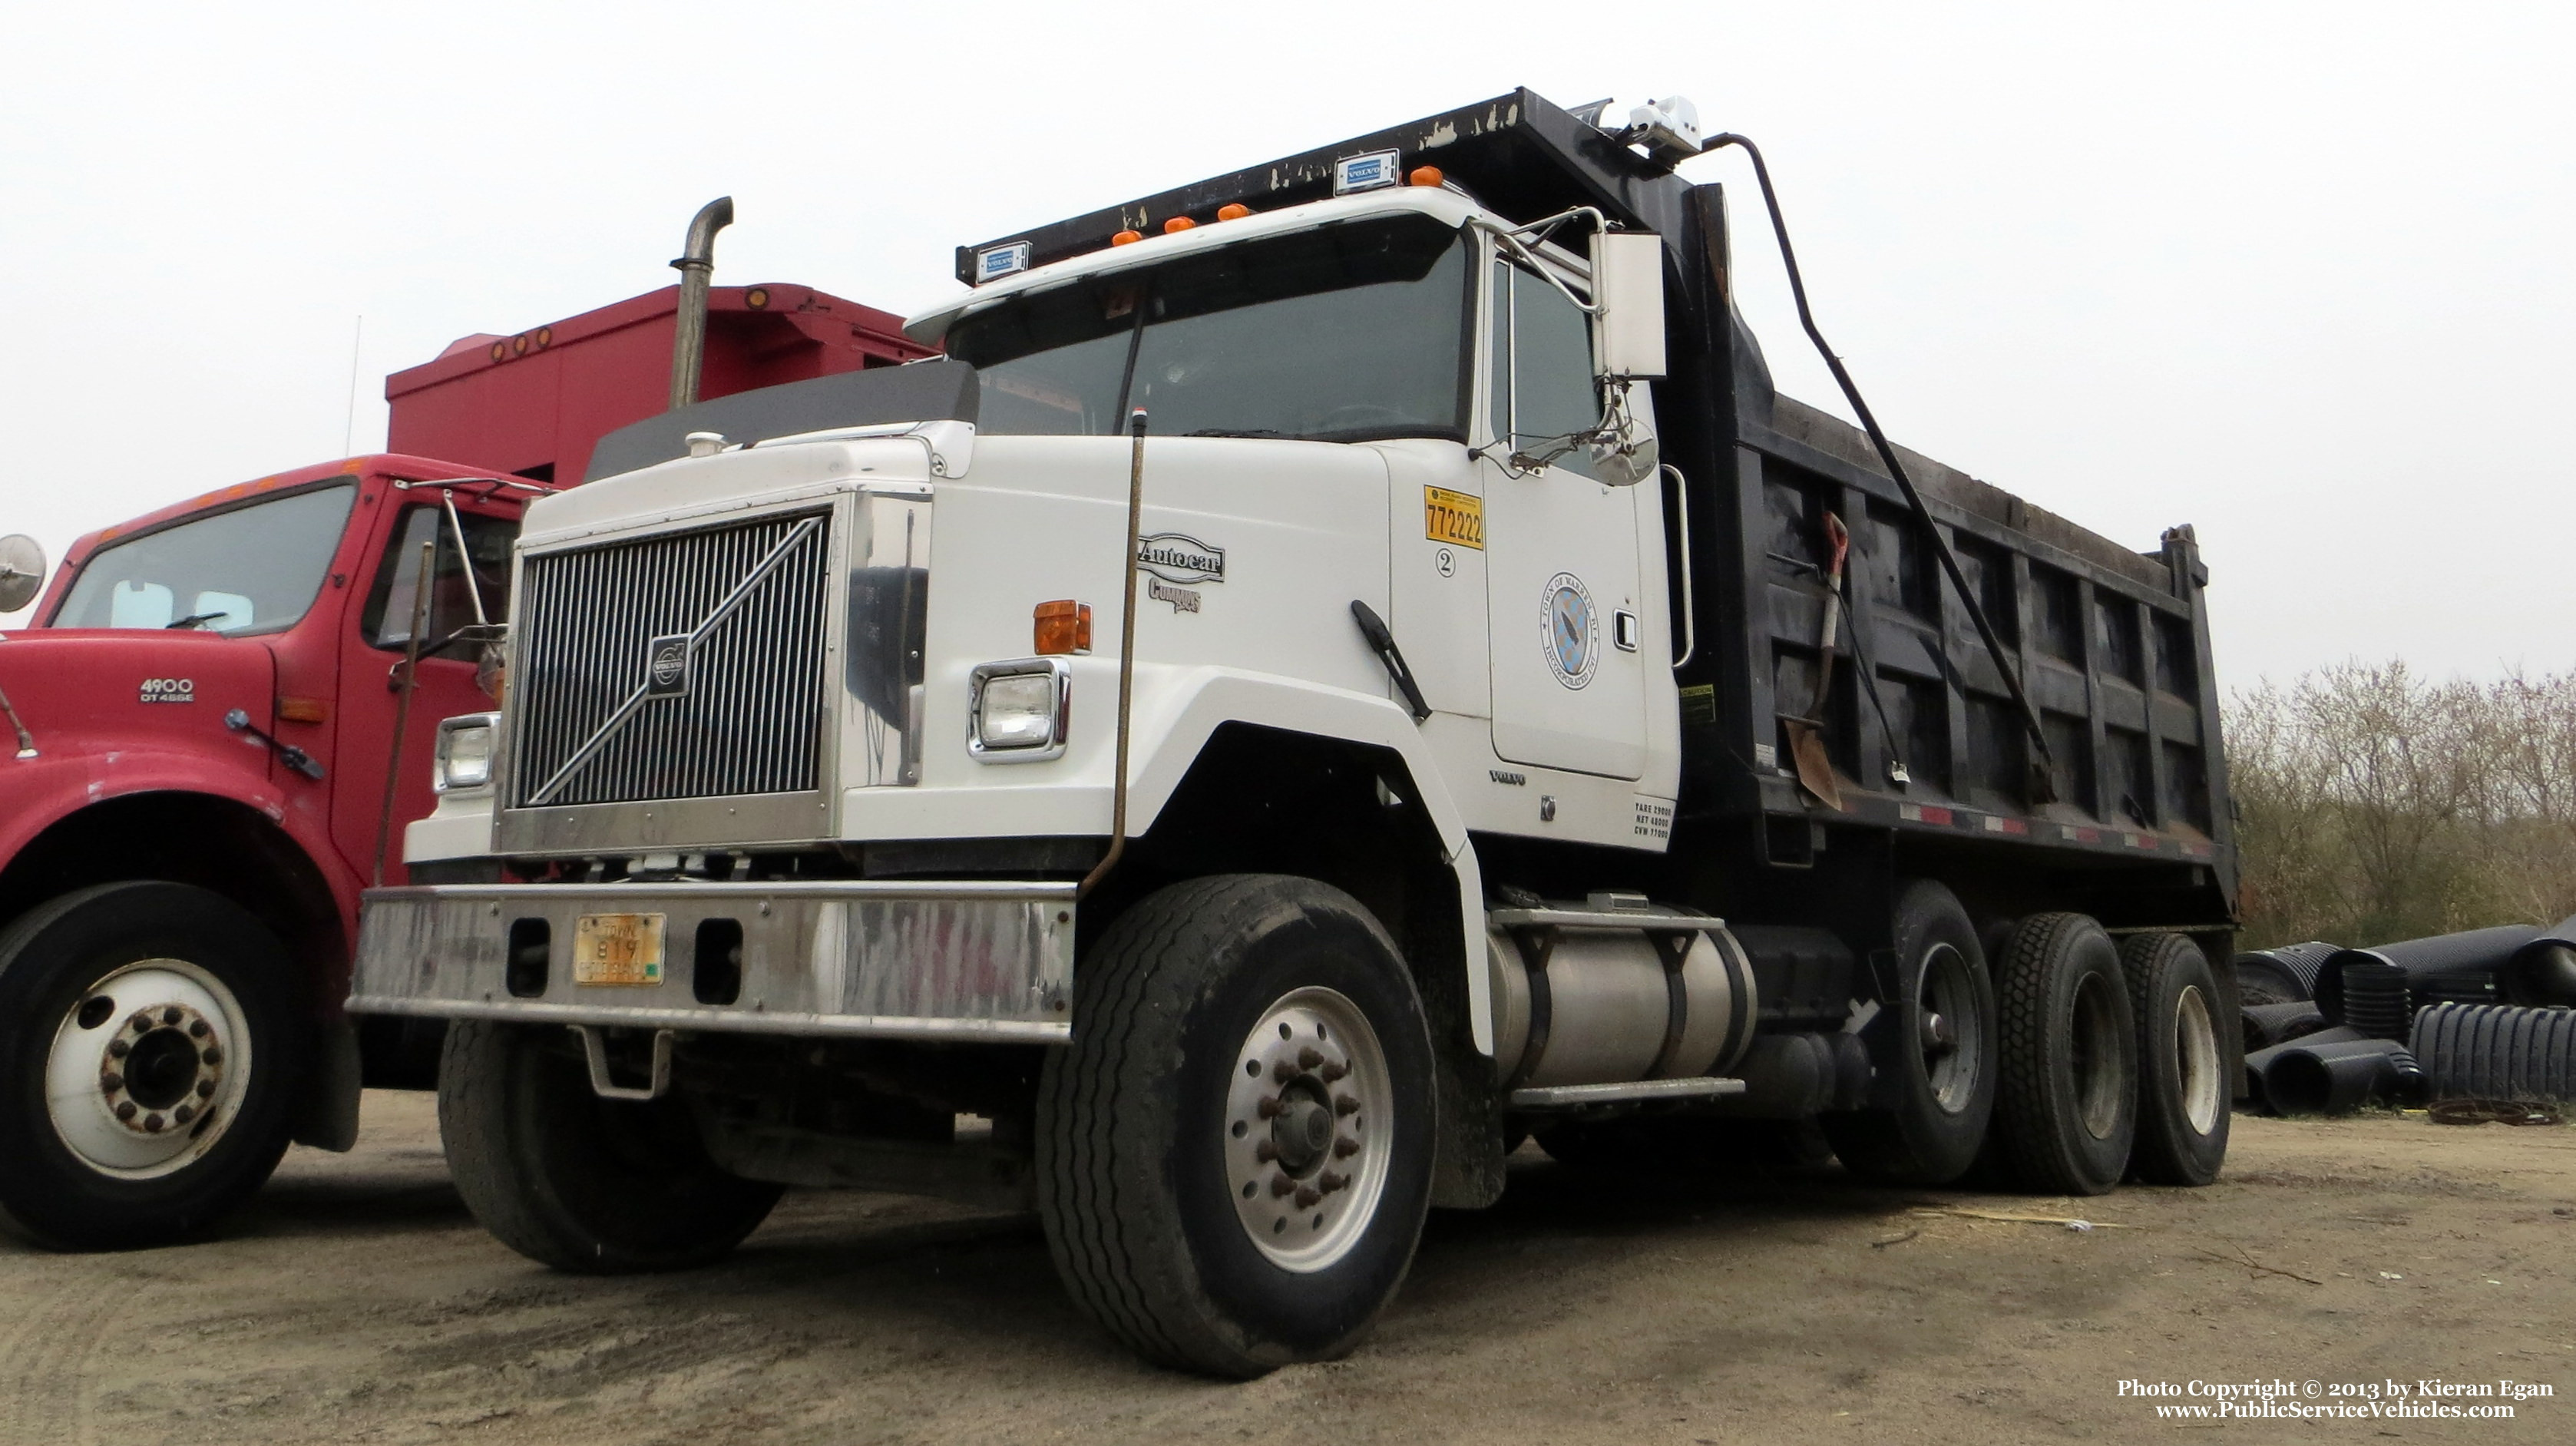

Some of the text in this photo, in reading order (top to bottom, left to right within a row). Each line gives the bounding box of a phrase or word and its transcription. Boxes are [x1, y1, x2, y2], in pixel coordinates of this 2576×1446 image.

[1348, 167, 1381, 178] VOLVO
[987, 257, 1013, 267] VOLVO
[1428, 505, 1481, 543] 772222
[1139, 541, 1221, 572] Autocar
[1440, 552, 1451, 574] 2
[1543, 585, 1556, 617] TOWN
[1554, 576, 1563, 588] OF
[1545, 645, 1589, 687] INCORPORATED
[141, 678, 193, 693] 4900
[1490, 770, 1526, 786] VOLVO
[1635, 802, 1652, 813] TARE
[1636, 815, 1648, 823] NET
[1634, 826, 1648, 835] GVW
